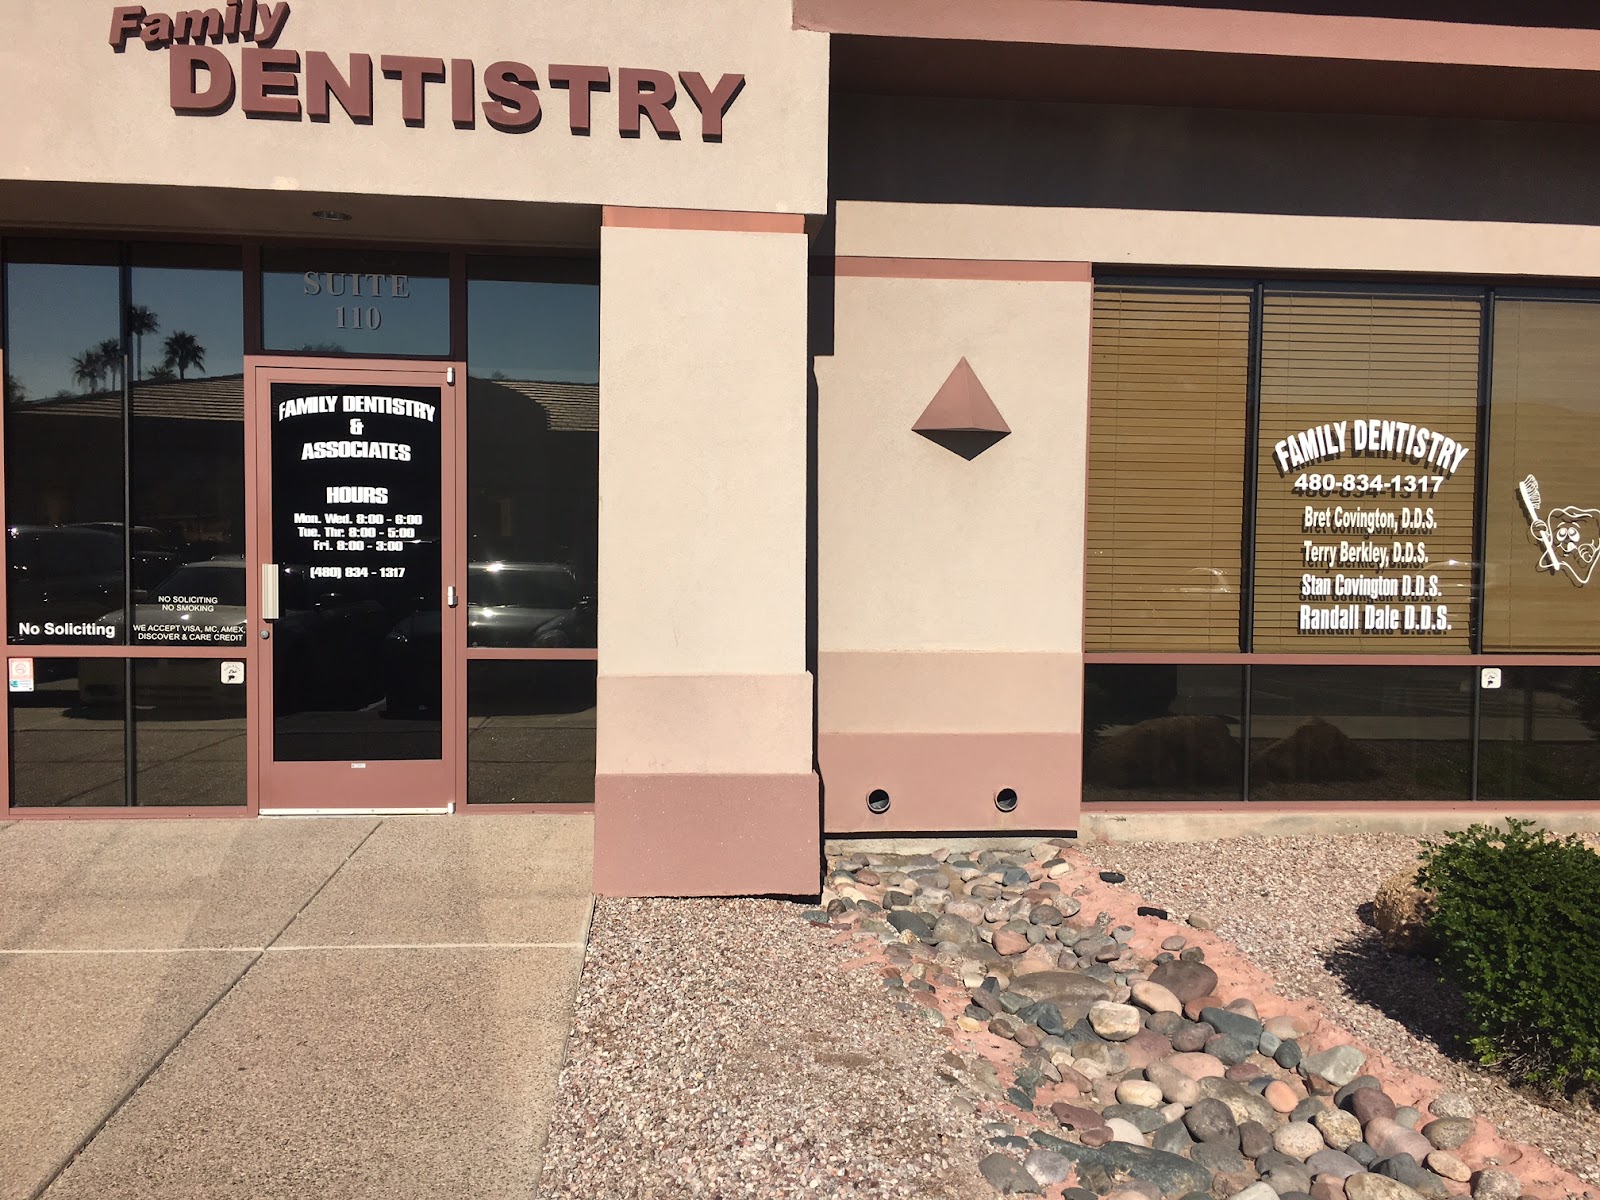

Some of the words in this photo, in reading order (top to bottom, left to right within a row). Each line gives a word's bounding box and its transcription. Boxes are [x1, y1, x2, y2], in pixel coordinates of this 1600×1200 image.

[109, 0, 290, 54] Family
[168, 45, 746, 143] DENTISTRY
[303, 271, 411, 298] SUITE
[336, 305, 382, 330] 110
[279, 395, 338, 422] FAMILY
[342, 395, 436, 422] DENTISTRY
[349, 418, 364, 435] &
[301, 441, 411, 461] ASSOCIATES
[1274, 420, 1348, 472] FAMILY
[1354, 419, 1470, 475] DENTISTRY
[1294, 473, 1445, 493] 480-834-1317
[326, 486, 389, 504] HOURS
[293, 513, 322, 524] Mon.
[324, 513, 353, 524] Wed.
[355, 513, 385, 525] 8:00
[395, 514, 423, 525] 6:00
[1304, 506, 1331, 528] Bret
[1334, 506, 1398, 534] Covington,
[1401, 507, 1437, 529] D.D.S.
[297, 526, 321, 537] Tue.
[324, 526, 346, 538] Thr.
[348, 527, 376, 538] 8:00
[387, 527, 415, 538] 5:00
[313, 540, 333, 551] Fri.
[336, 540, 365, 551] 8:00
[376, 540, 403, 551] 3:00
[1303, 540, 1337, 568] Terry
[1340, 541, 1389, 569] Berkley,
[1393, 541, 1429, 563] D.D.S.
[309, 566, 342, 579] (480)
[345, 567, 369, 578] 834
[379, 567, 406, 578] 1317
[1301, 573, 1331, 596] Stan
[1335, 573, 1398, 600] Covington
[1401, 575, 1442, 597] D.D.S.
[158, 595, 171, 603] NO
[172, 596, 218, 604] SOLICITING
[161, 604, 175, 612] NO
[176, 604, 215, 612] SMOKING
[1299, 604, 1359, 630] Randall
[1364, 604, 1399, 630] Dale
[1404, 605, 1452, 631] D.D.S.
[18, 622, 40, 635] No
[44, 622, 116, 639] Soliciting
[133, 624, 146, 632] WE
[182, 625, 203, 634] VISA,
[138, 633, 180, 641] DISCOVER
[181, 633, 188, 641] &
[189, 633, 212, 641] CARE
[213, 633, 244, 642] CREDIT
